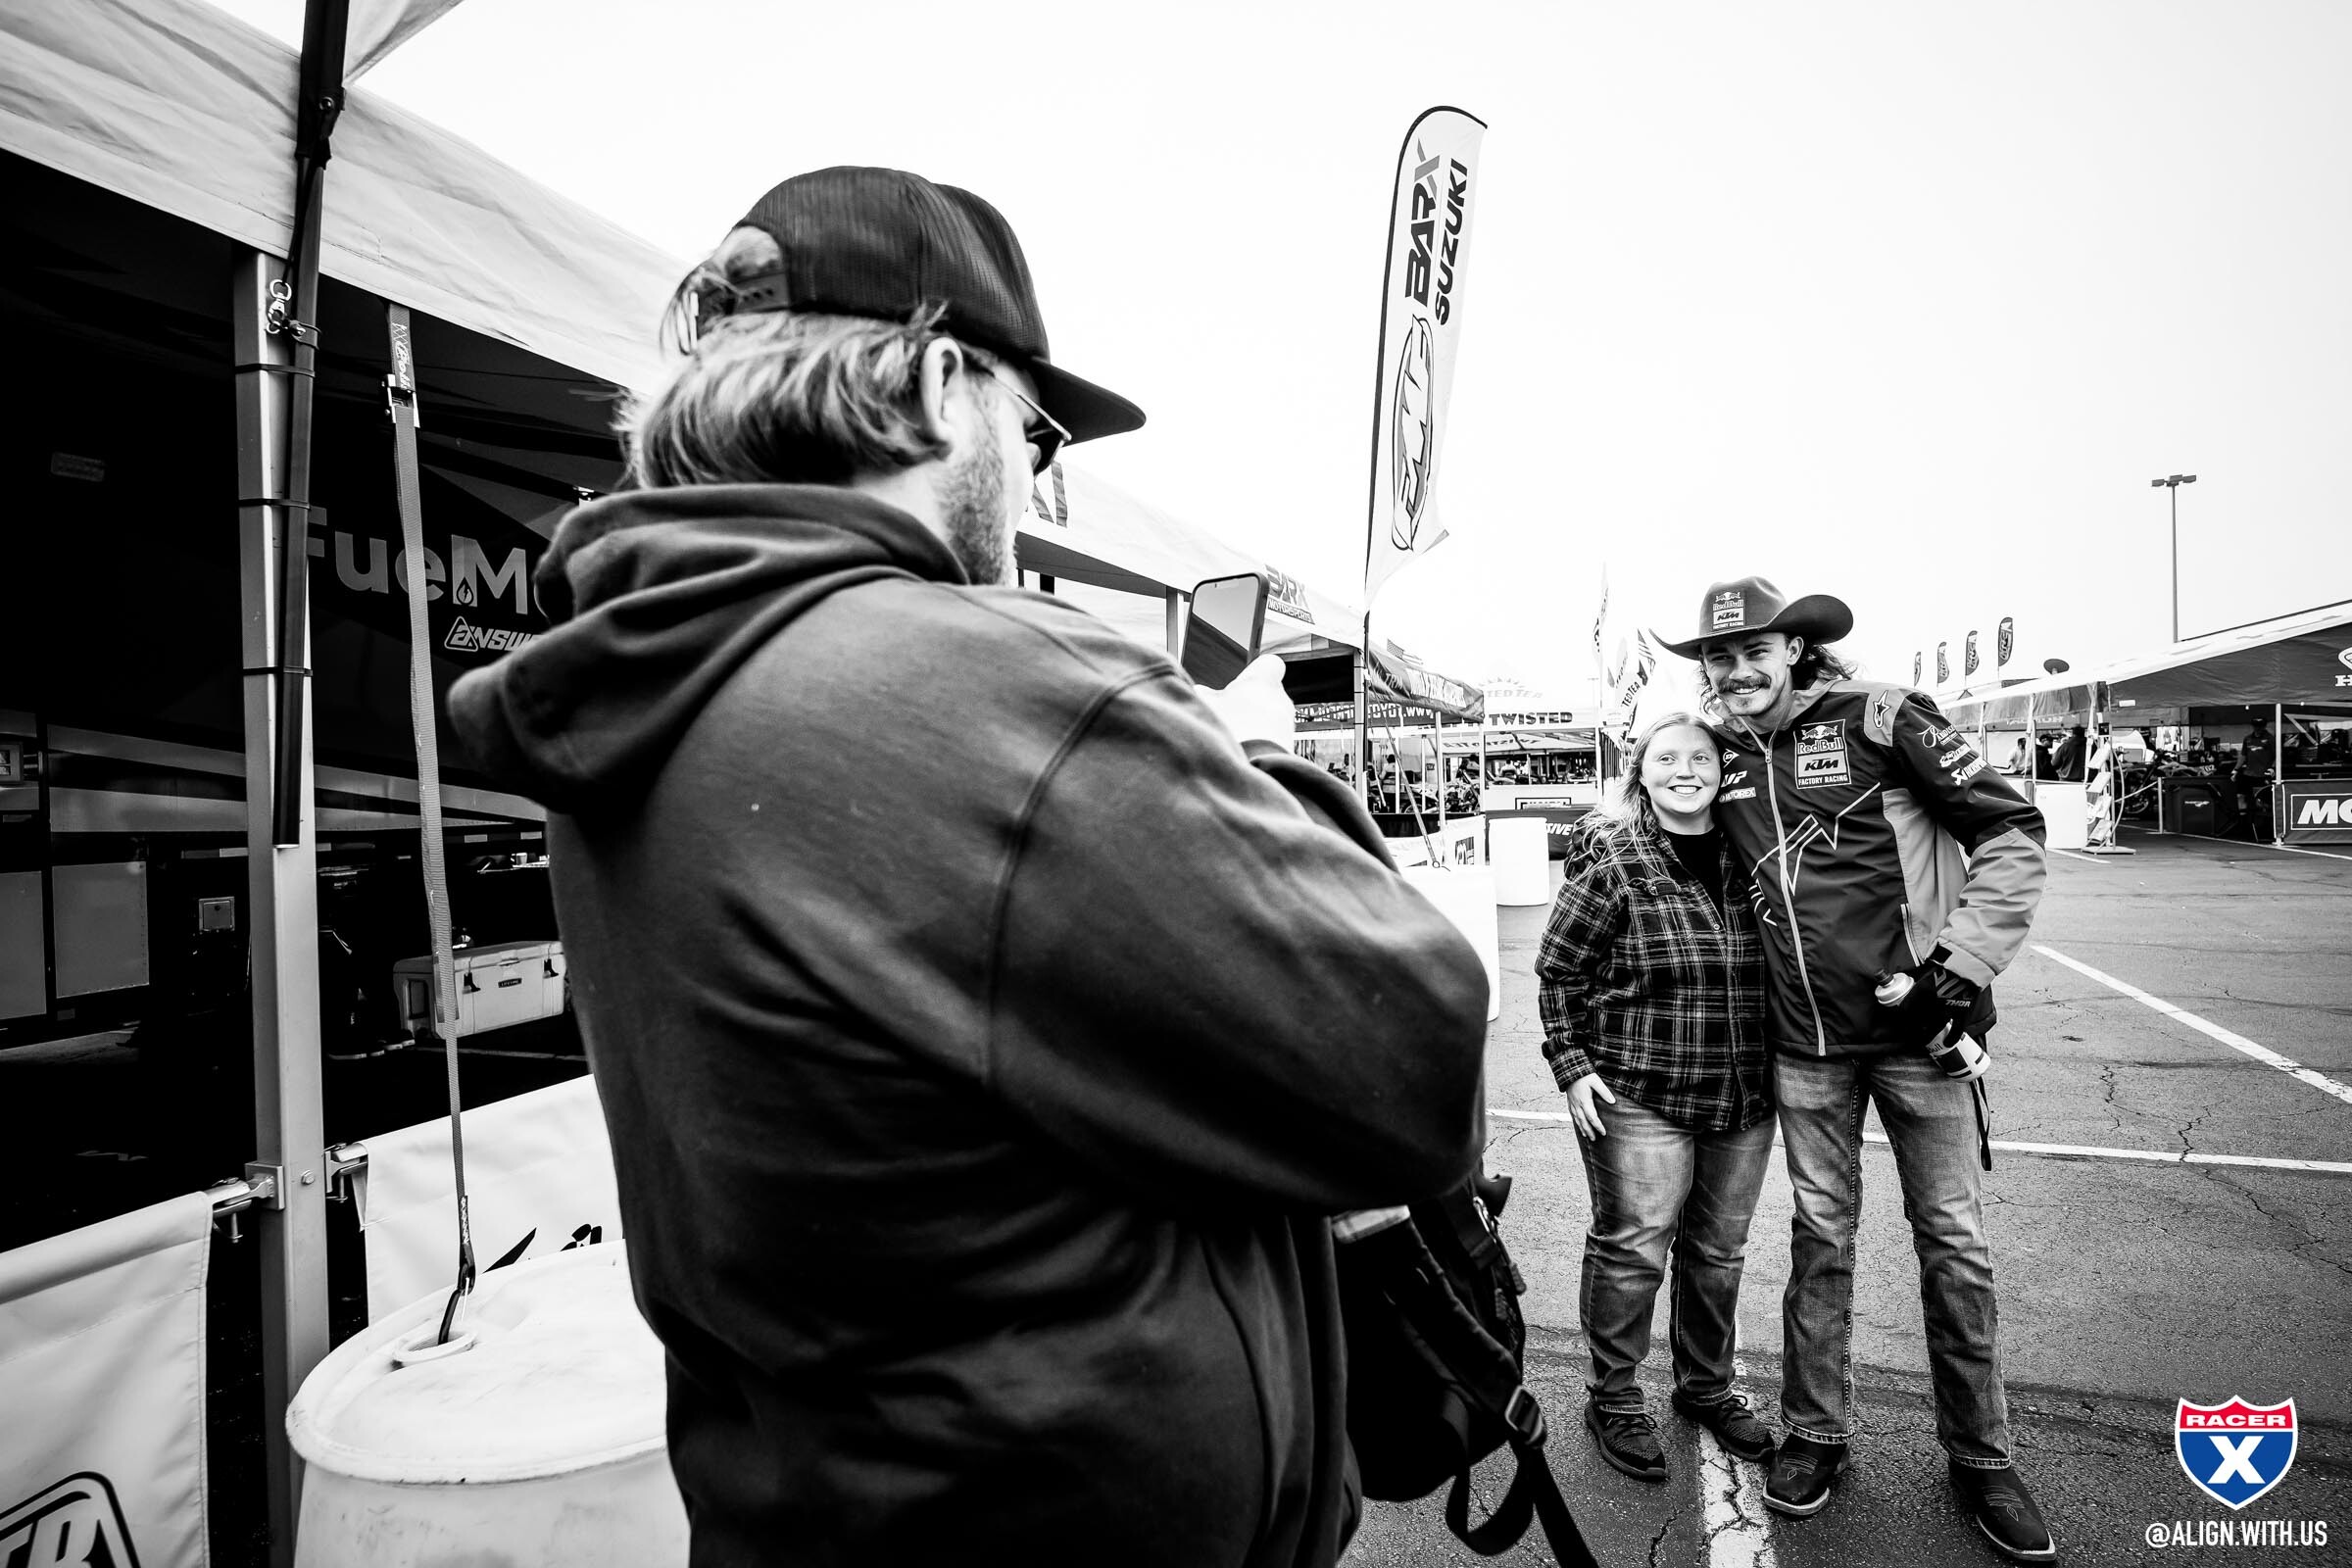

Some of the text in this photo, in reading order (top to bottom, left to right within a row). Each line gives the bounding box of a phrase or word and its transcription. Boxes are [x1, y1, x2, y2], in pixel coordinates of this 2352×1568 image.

[1405, 138, 1441, 309] BARX
[1436, 158, 1468, 325] SUZUKI
[1489, 711, 1573, 726] TWISTED
[1797, 737, 1844, 755] Red Bull
[1804, 758, 1839, 771] KTM
[1798, 774, 1848, 786] FACTORY RACING
[1945, 999, 1971, 1007] THOR
